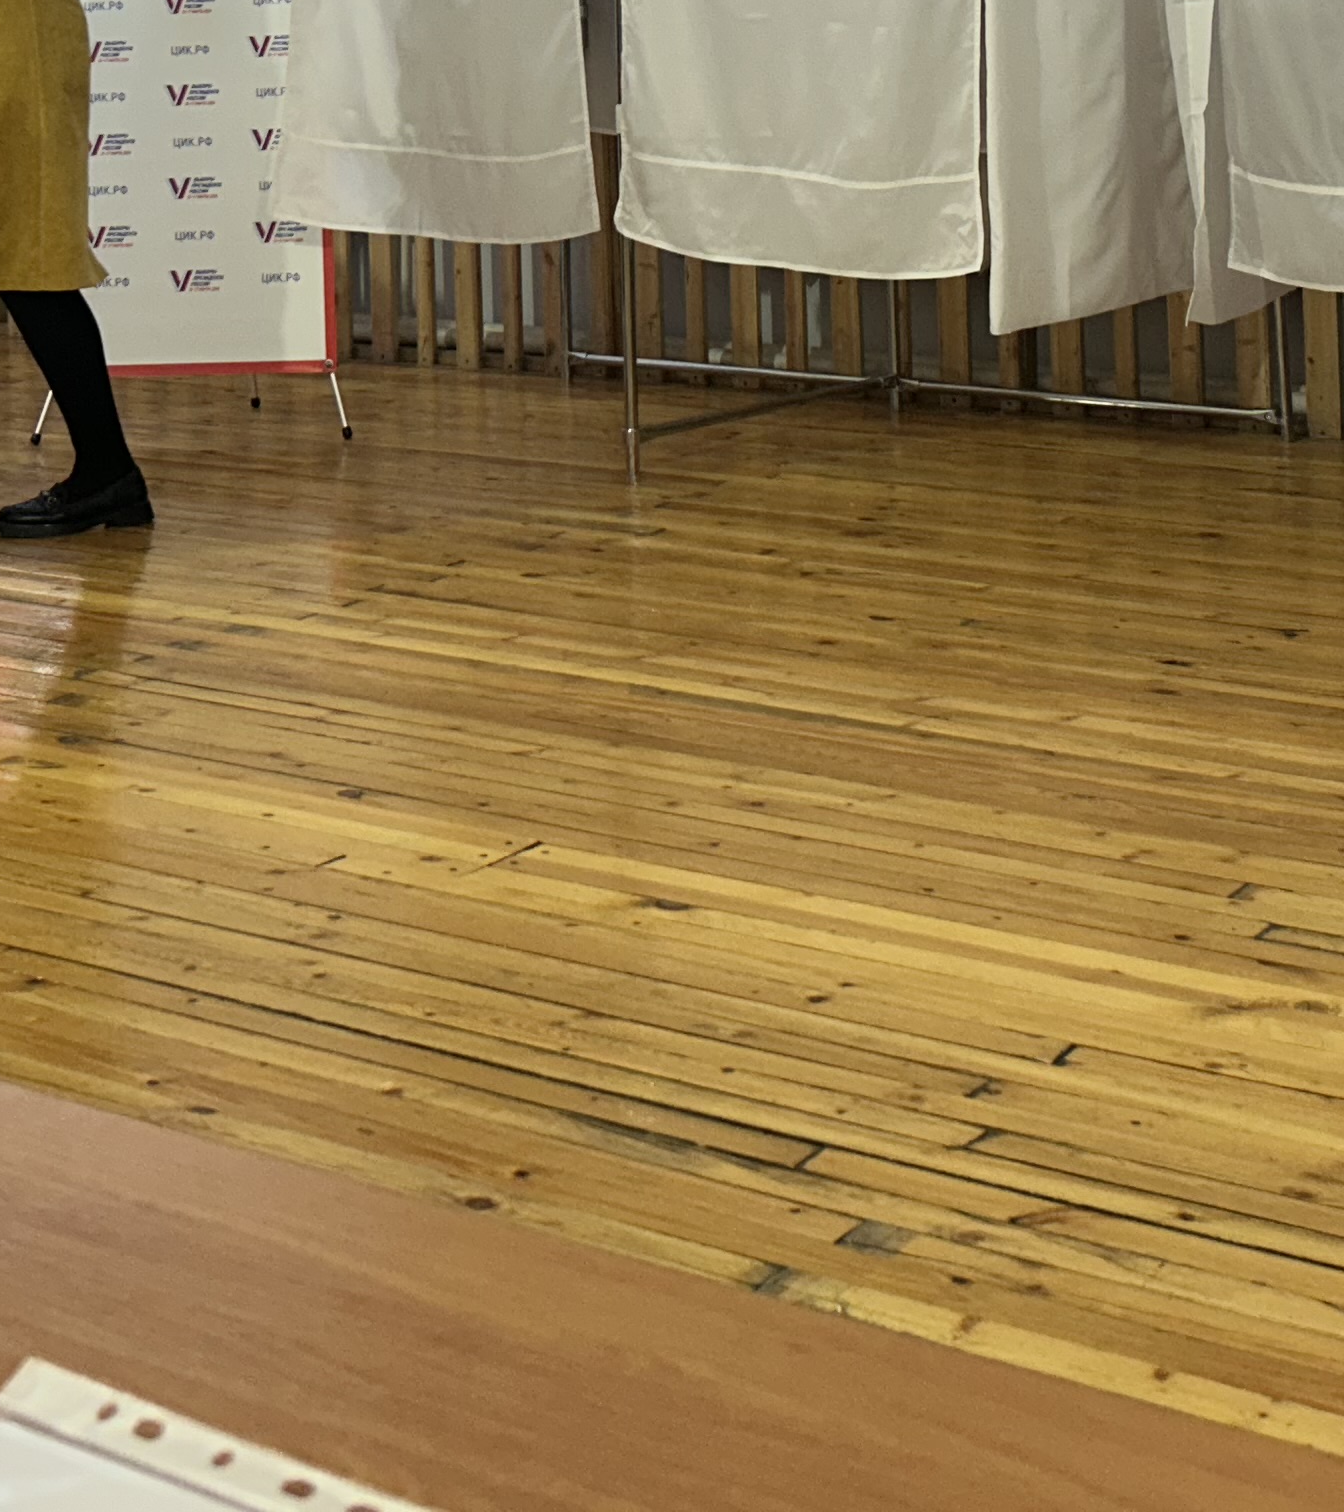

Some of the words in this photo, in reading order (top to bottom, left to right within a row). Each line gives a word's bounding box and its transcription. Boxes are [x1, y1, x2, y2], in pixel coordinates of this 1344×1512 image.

[170, 44, 210, 57] ЦИК.РФ
[172, 137, 213, 150] ЦИК.РФ
[174, 230, 216, 243] ЦИК.РФ
[261, 272, 301, 285] ЦИК.РФ
